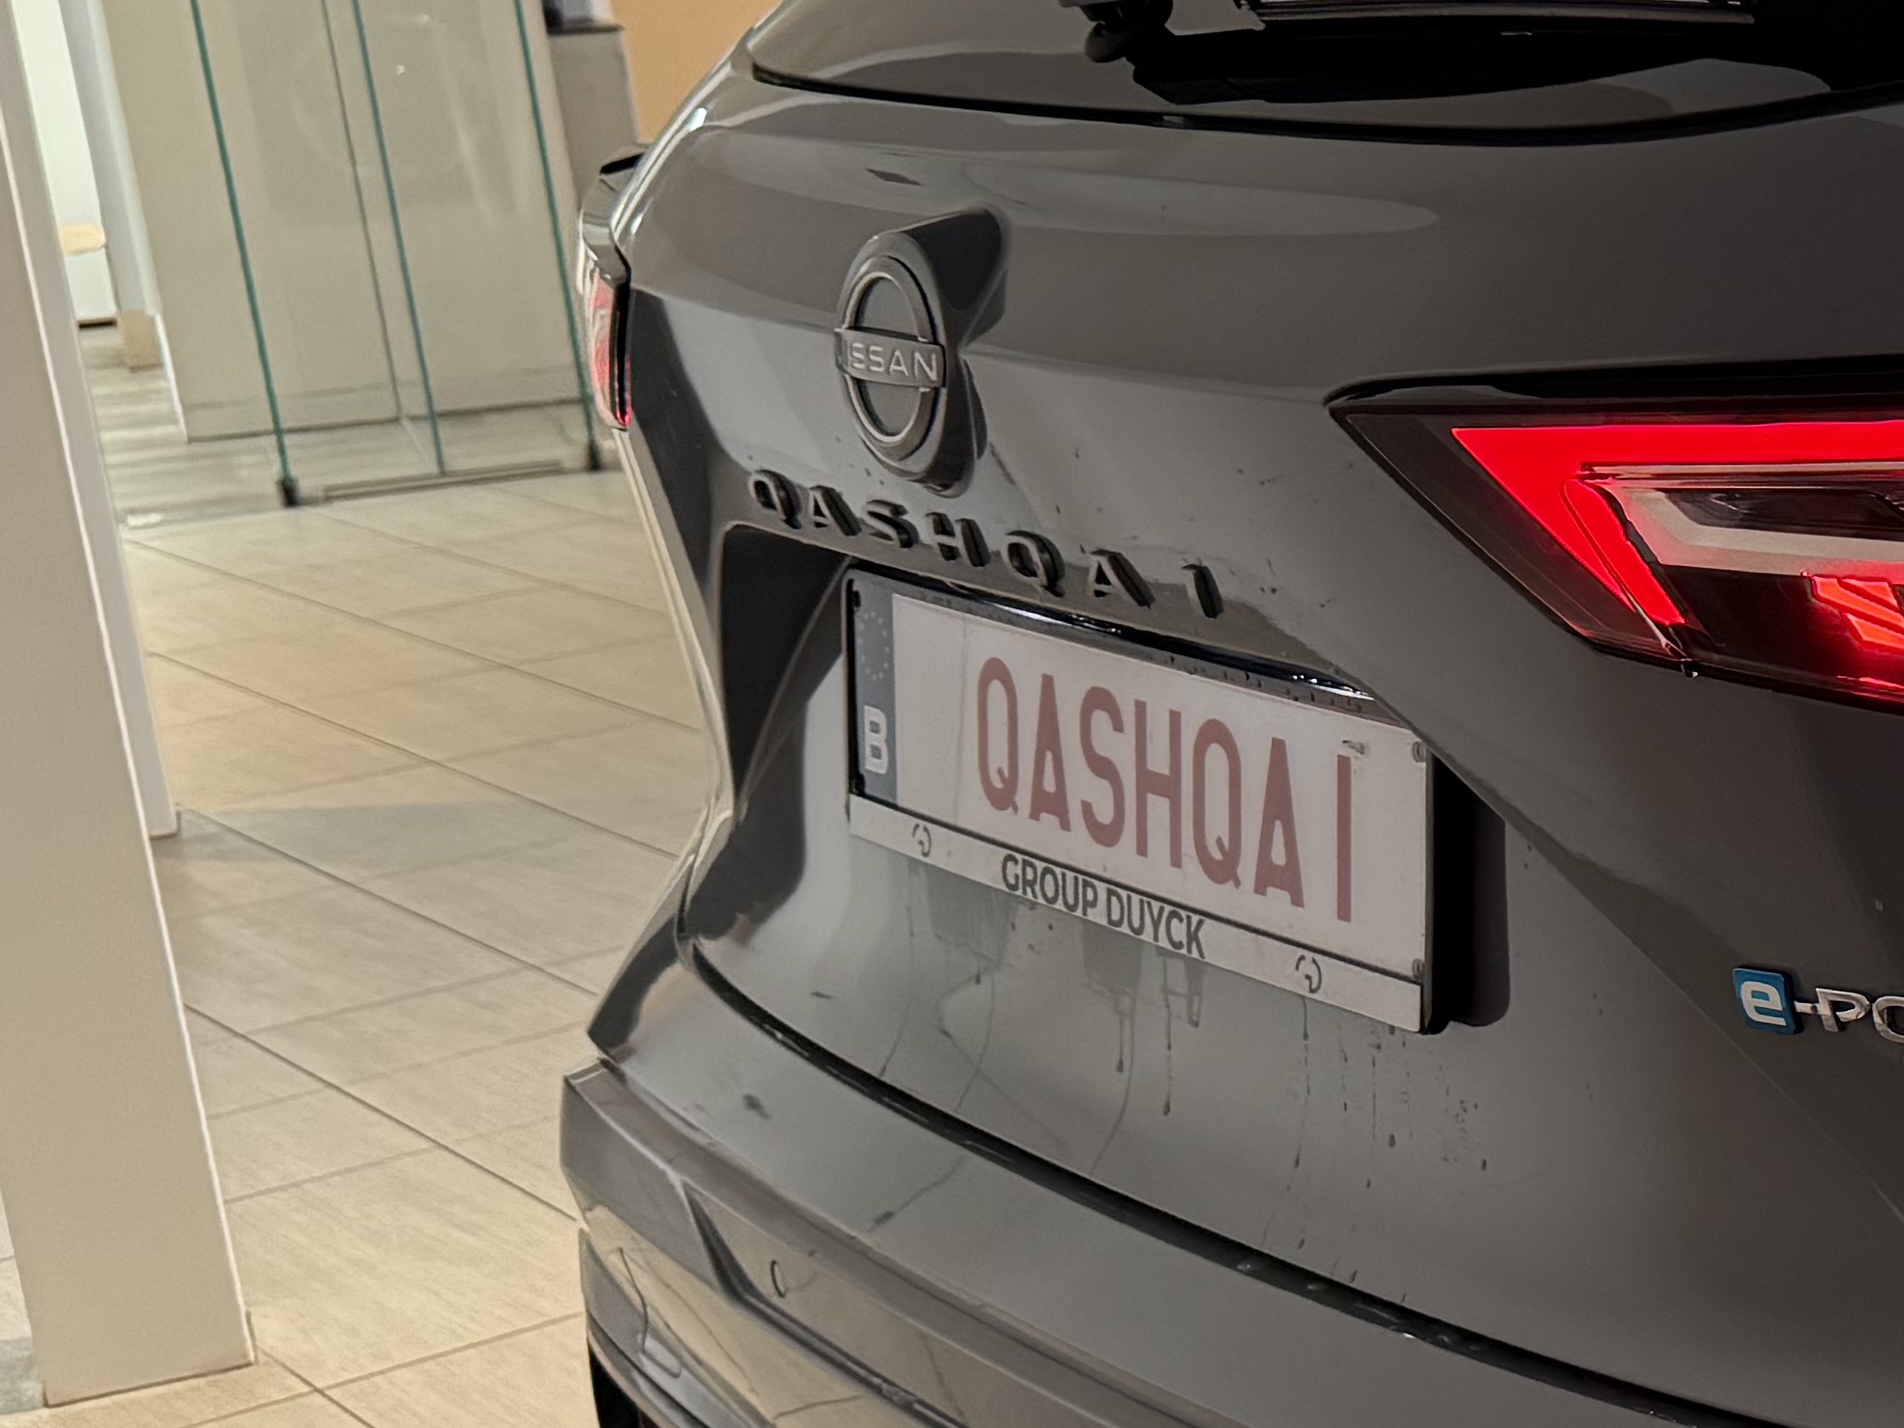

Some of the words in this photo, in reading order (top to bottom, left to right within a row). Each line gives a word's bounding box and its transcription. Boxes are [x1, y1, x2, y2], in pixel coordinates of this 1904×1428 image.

[842, 338, 938, 382] SSAN
[748, 469, 1224, 619] QASHQAI
[863, 706, 889, 776] B
[975, 657, 1353, 923] QASHQAI
[1001, 853, 1099, 918] GROUP
[1106, 894, 1207, 960] DUYCK
